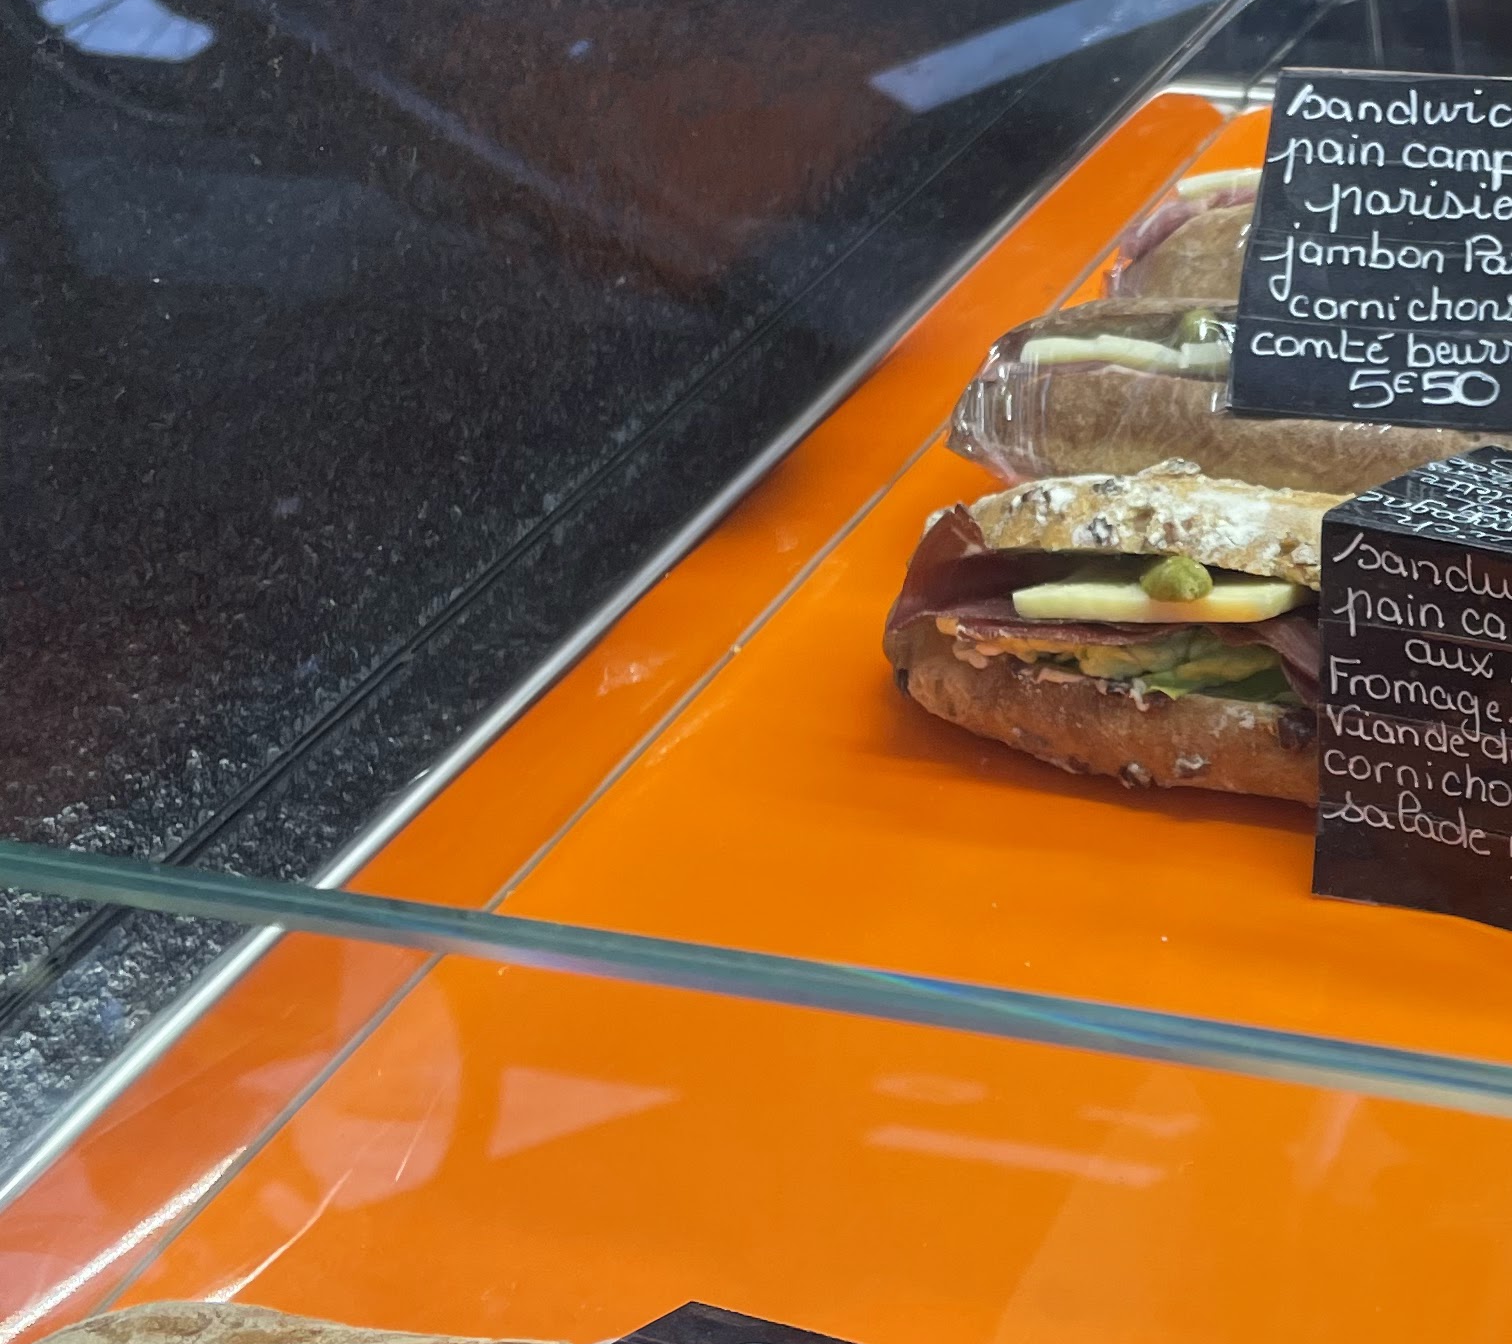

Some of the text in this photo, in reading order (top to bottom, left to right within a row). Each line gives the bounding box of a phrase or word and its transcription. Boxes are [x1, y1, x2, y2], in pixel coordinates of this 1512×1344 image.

[1267, 134, 1385, 184] pain
[1259, 222, 1445, 302] jambon
[1252, 331, 1391, 366] comté
[1332, 586, 1444, 637] pain
[1405, 637, 1493, 678] aux
[1329, 655, 1502, 742] Fromage
[1326, 703, 1470, 758] Viande
[1323, 790, 1491, 856] salade
